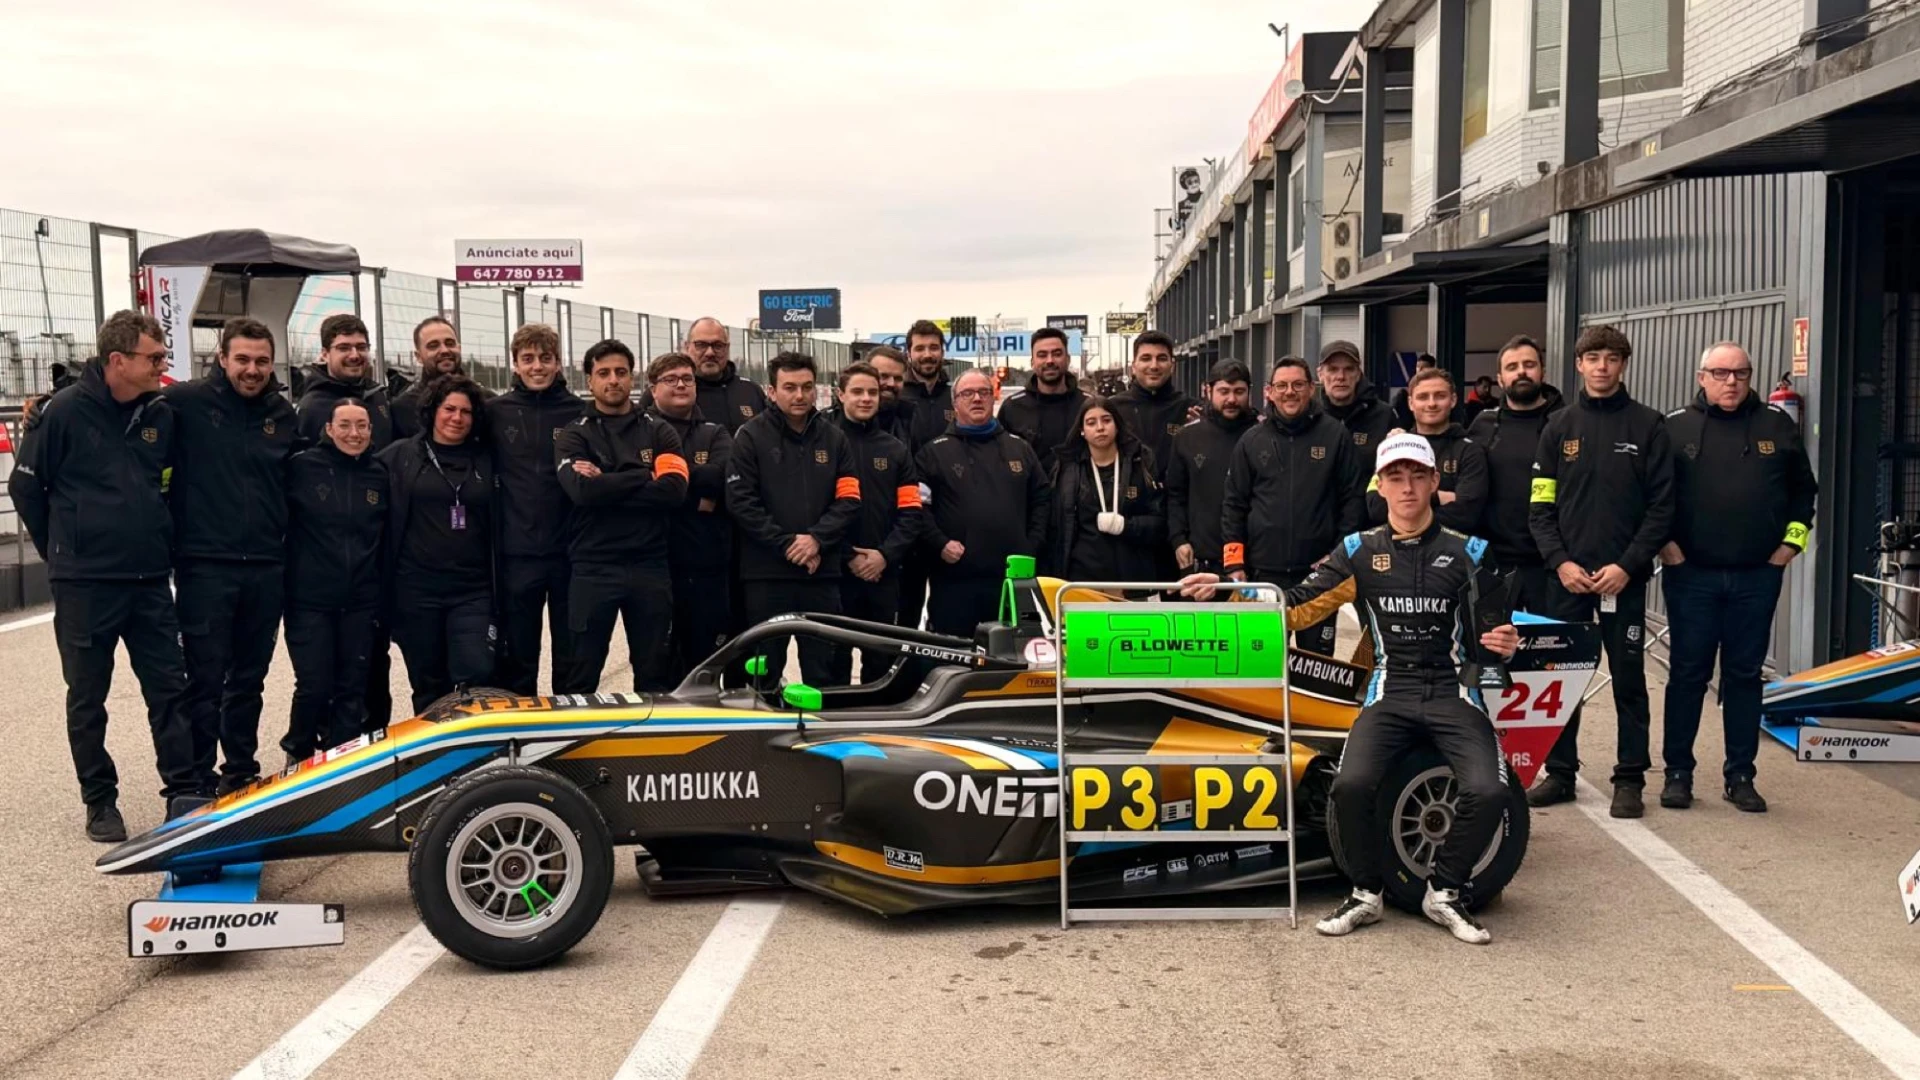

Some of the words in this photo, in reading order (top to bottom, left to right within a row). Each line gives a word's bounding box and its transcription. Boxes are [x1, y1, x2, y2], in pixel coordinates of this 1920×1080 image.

[466, 246, 538, 258] Anúnciate
[542, 246, 574, 260] aquí
[473, 268, 500, 280] 647
[504, 268, 533, 280] 780
[536, 268, 565, 279] 912
[763, 295, 780, 310] GO
[781, 294, 834, 309] ELECTRIC
[783, 308, 814, 323] Ford
[1378, 596, 1448, 614] KAMBUKKA
[1141, 639, 1230, 652] LOWETTE
[915, 646, 973, 664] LOWETTE
[1288, 653, 1355, 688] KAMBUKKA
[1496, 680, 1563, 722] 24
[627, 770, 760, 803] KAMBUKKA
